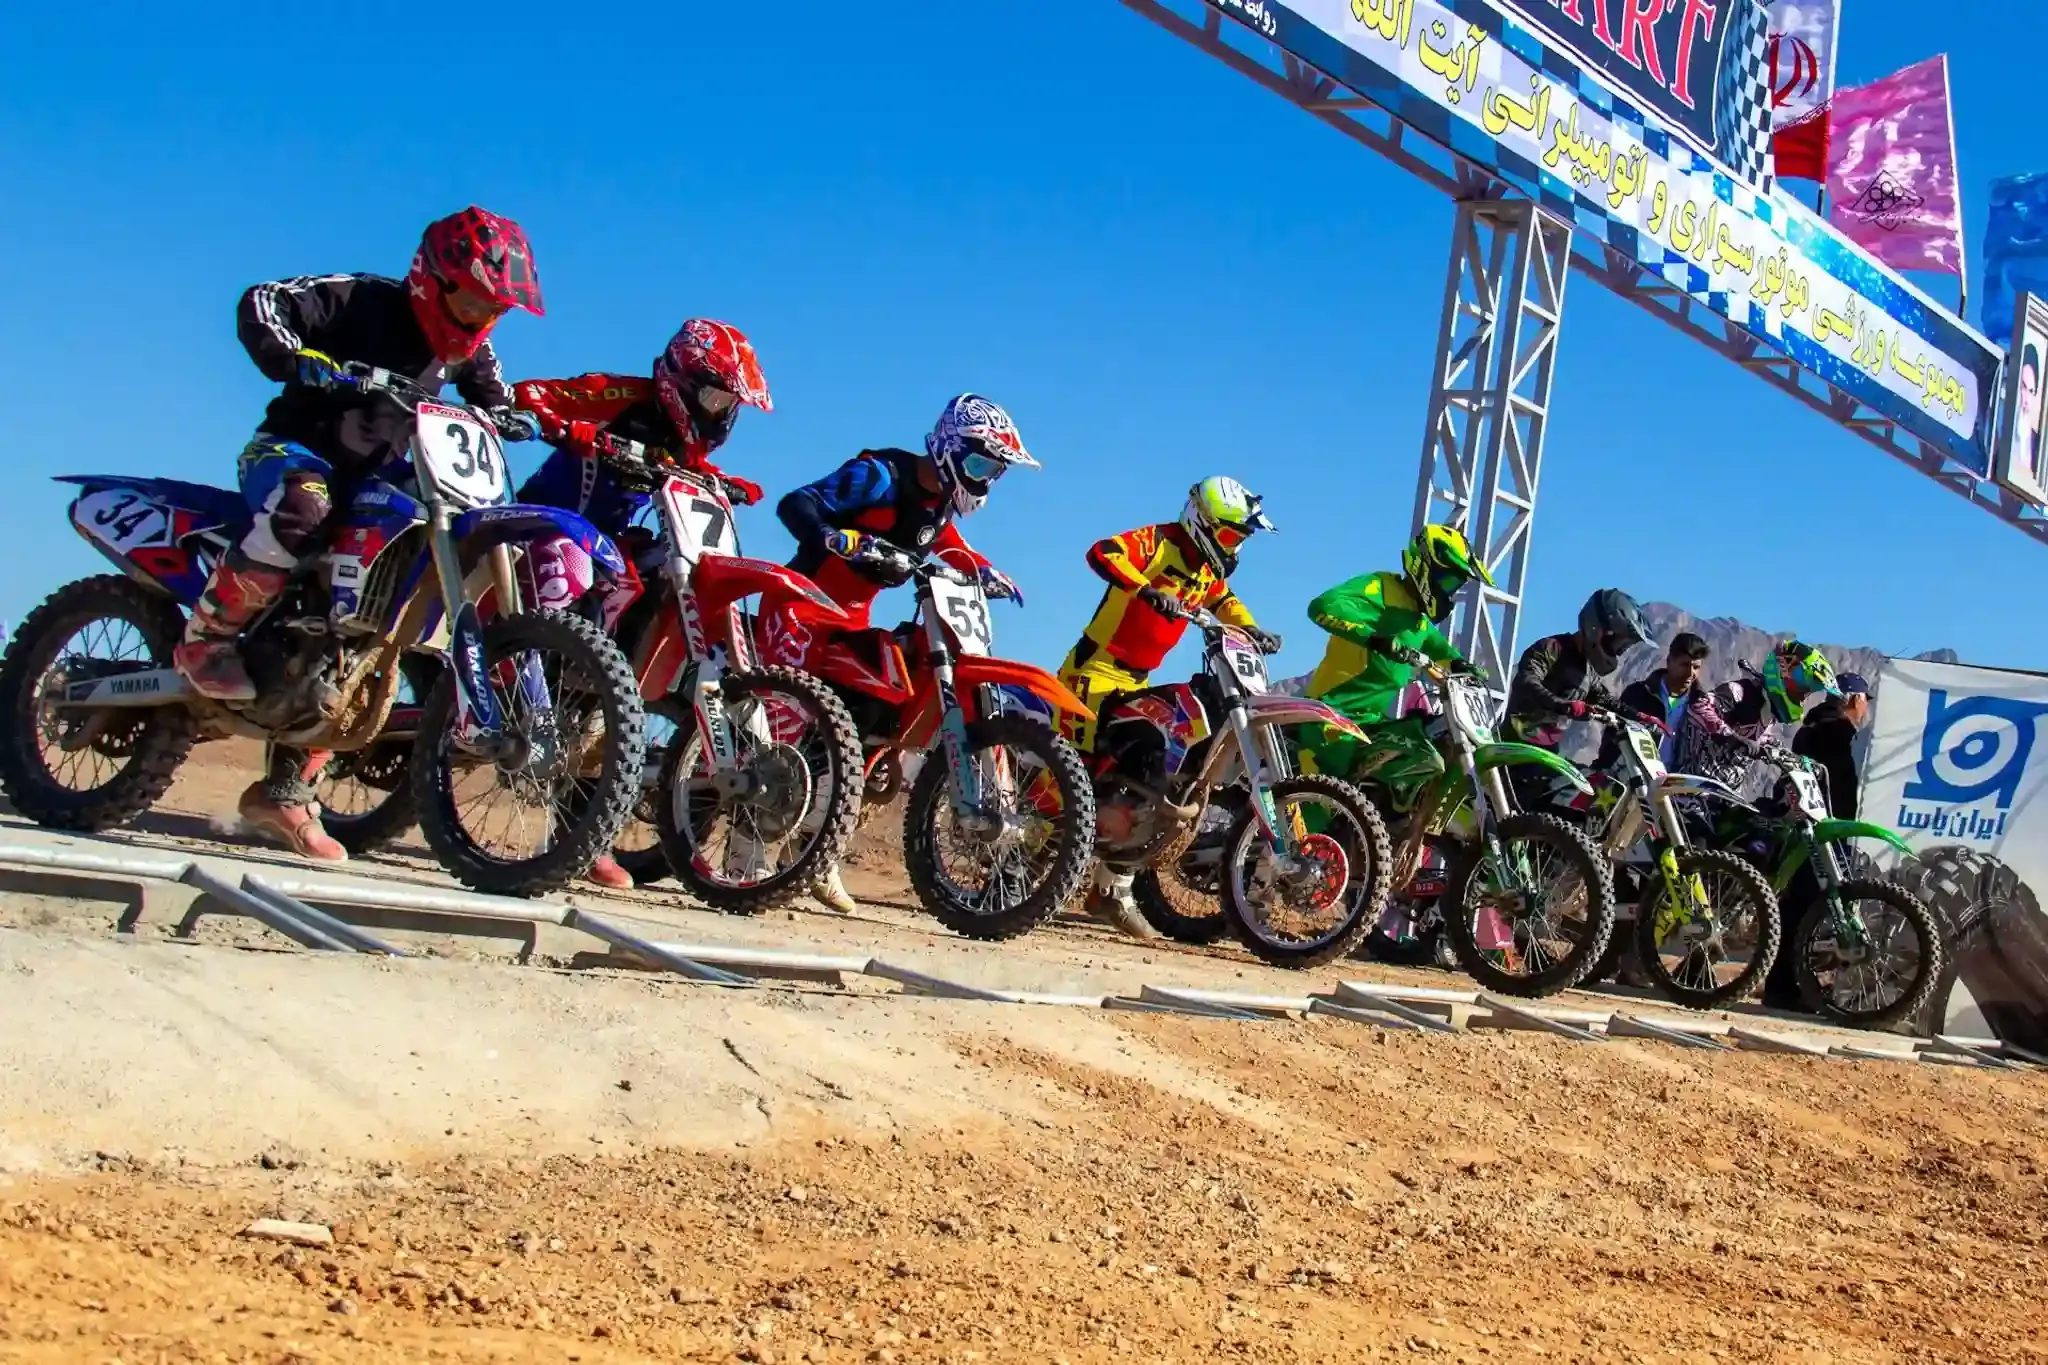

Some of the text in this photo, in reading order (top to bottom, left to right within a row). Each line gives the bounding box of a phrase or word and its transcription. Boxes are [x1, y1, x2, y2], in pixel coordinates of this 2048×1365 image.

[1418, 20, 1489, 105] آیت
[1647, 180, 1668, 234] و
[1812, 292, 1885, 377] ورزشی
[446, 422, 496, 487] 34
[94, 494, 155, 542] 34
[690, 498, 726, 549] 7
[945, 595, 990, 645] 53
[109, 677, 161, 694] YAMAHA
[1897, 803, 2008, 840] ایران یاسا
